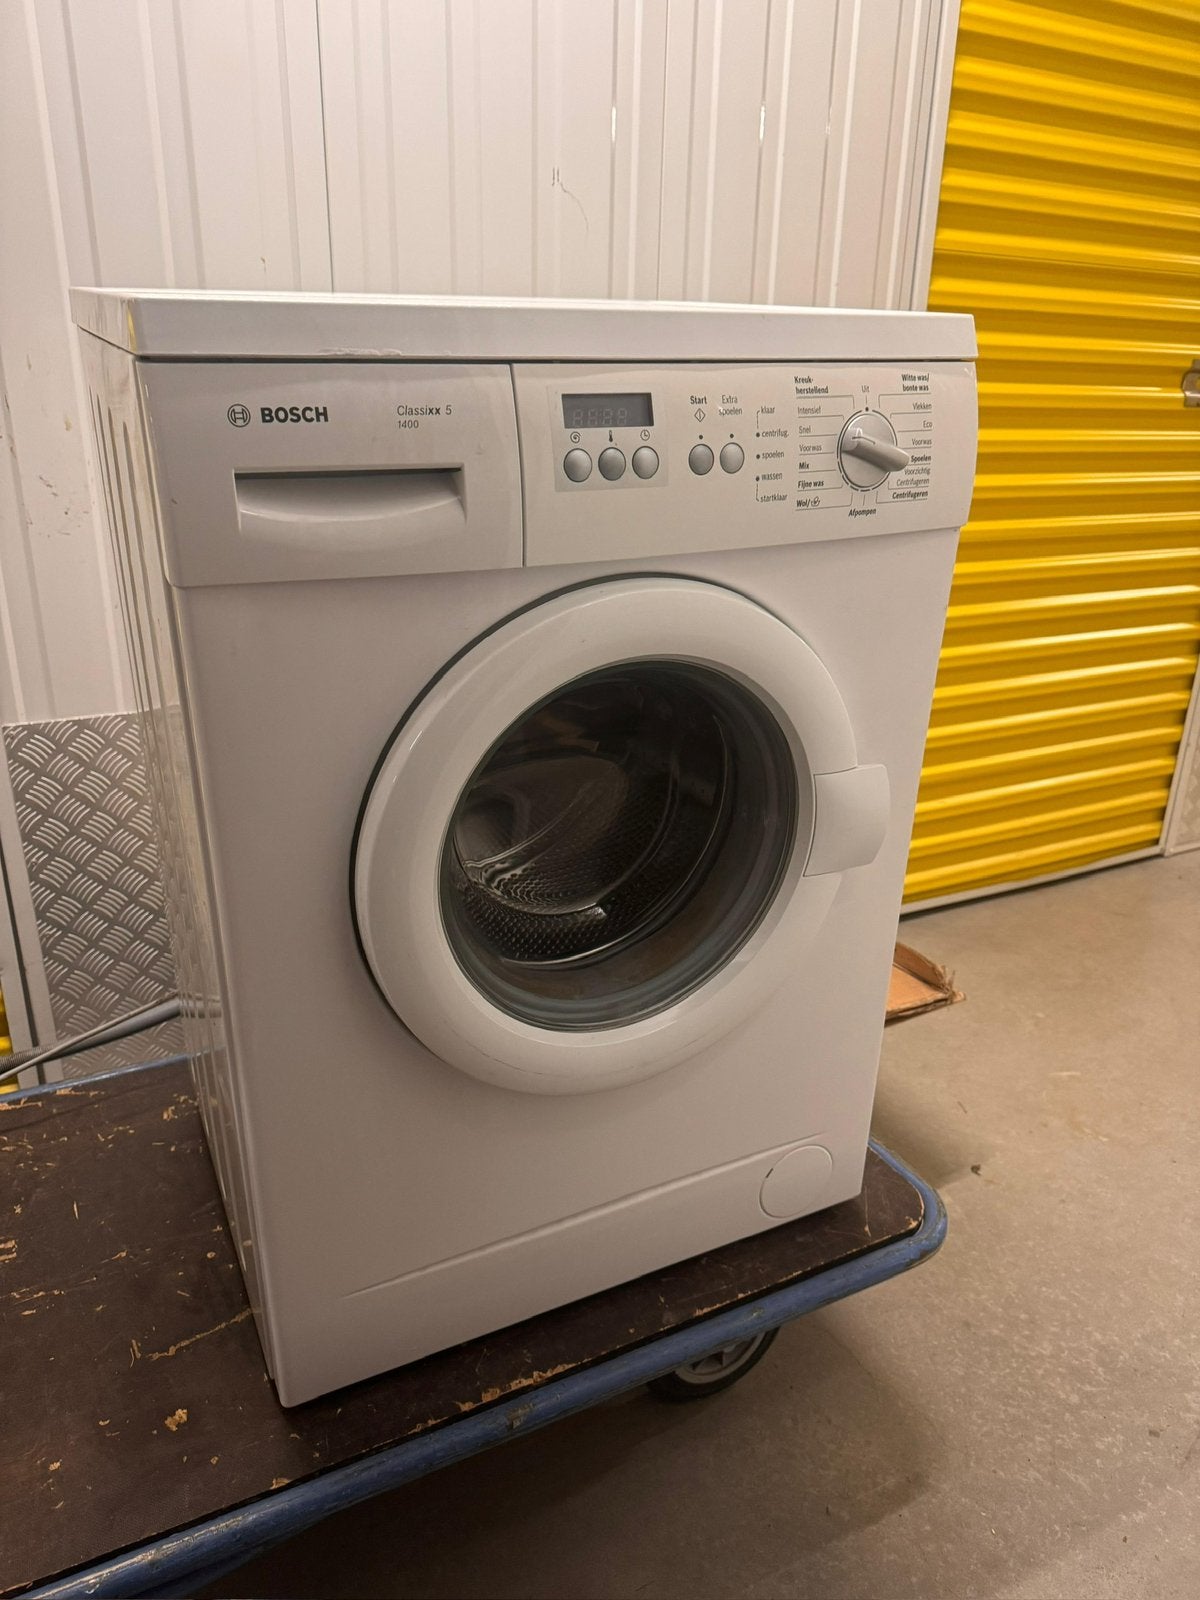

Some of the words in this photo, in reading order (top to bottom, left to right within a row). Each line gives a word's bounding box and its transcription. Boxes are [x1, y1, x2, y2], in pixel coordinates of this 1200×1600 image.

[902, 374, 917, 382] Witte
[917, 374, 929, 382] was/
[796, 386, 828, 394] herstellend
[902, 384, 917, 392] bonte
[690, 395, 707, 404] Start
[722, 395, 738, 404] Extra
[260, 406, 329, 423] BOSCH
[397, 405, 441, 416] Classixx
[445, 405, 452, 415] 5
[719, 407, 742, 416] spoelen
[761, 406, 775, 414] klaar
[397, 420, 419, 429] 1400
[761, 429, 789, 438] centrifug.
[912, 438, 932, 446] Voorwas
[762, 450, 784, 459] spoelen
[911, 455, 931, 463] Spoelen
[904, 467, 930, 475] Voorzichtig
[761, 472, 782, 480] wassen
[798, 480, 812, 489] Fijne
[897, 477, 929, 487] Centrifugeren
[760, 494, 787, 502] startklaar
[892, 491, 928, 499] Centrifugeren
[796, 498, 810, 508] Wol/
[848, 508, 876, 517] Afpompen
